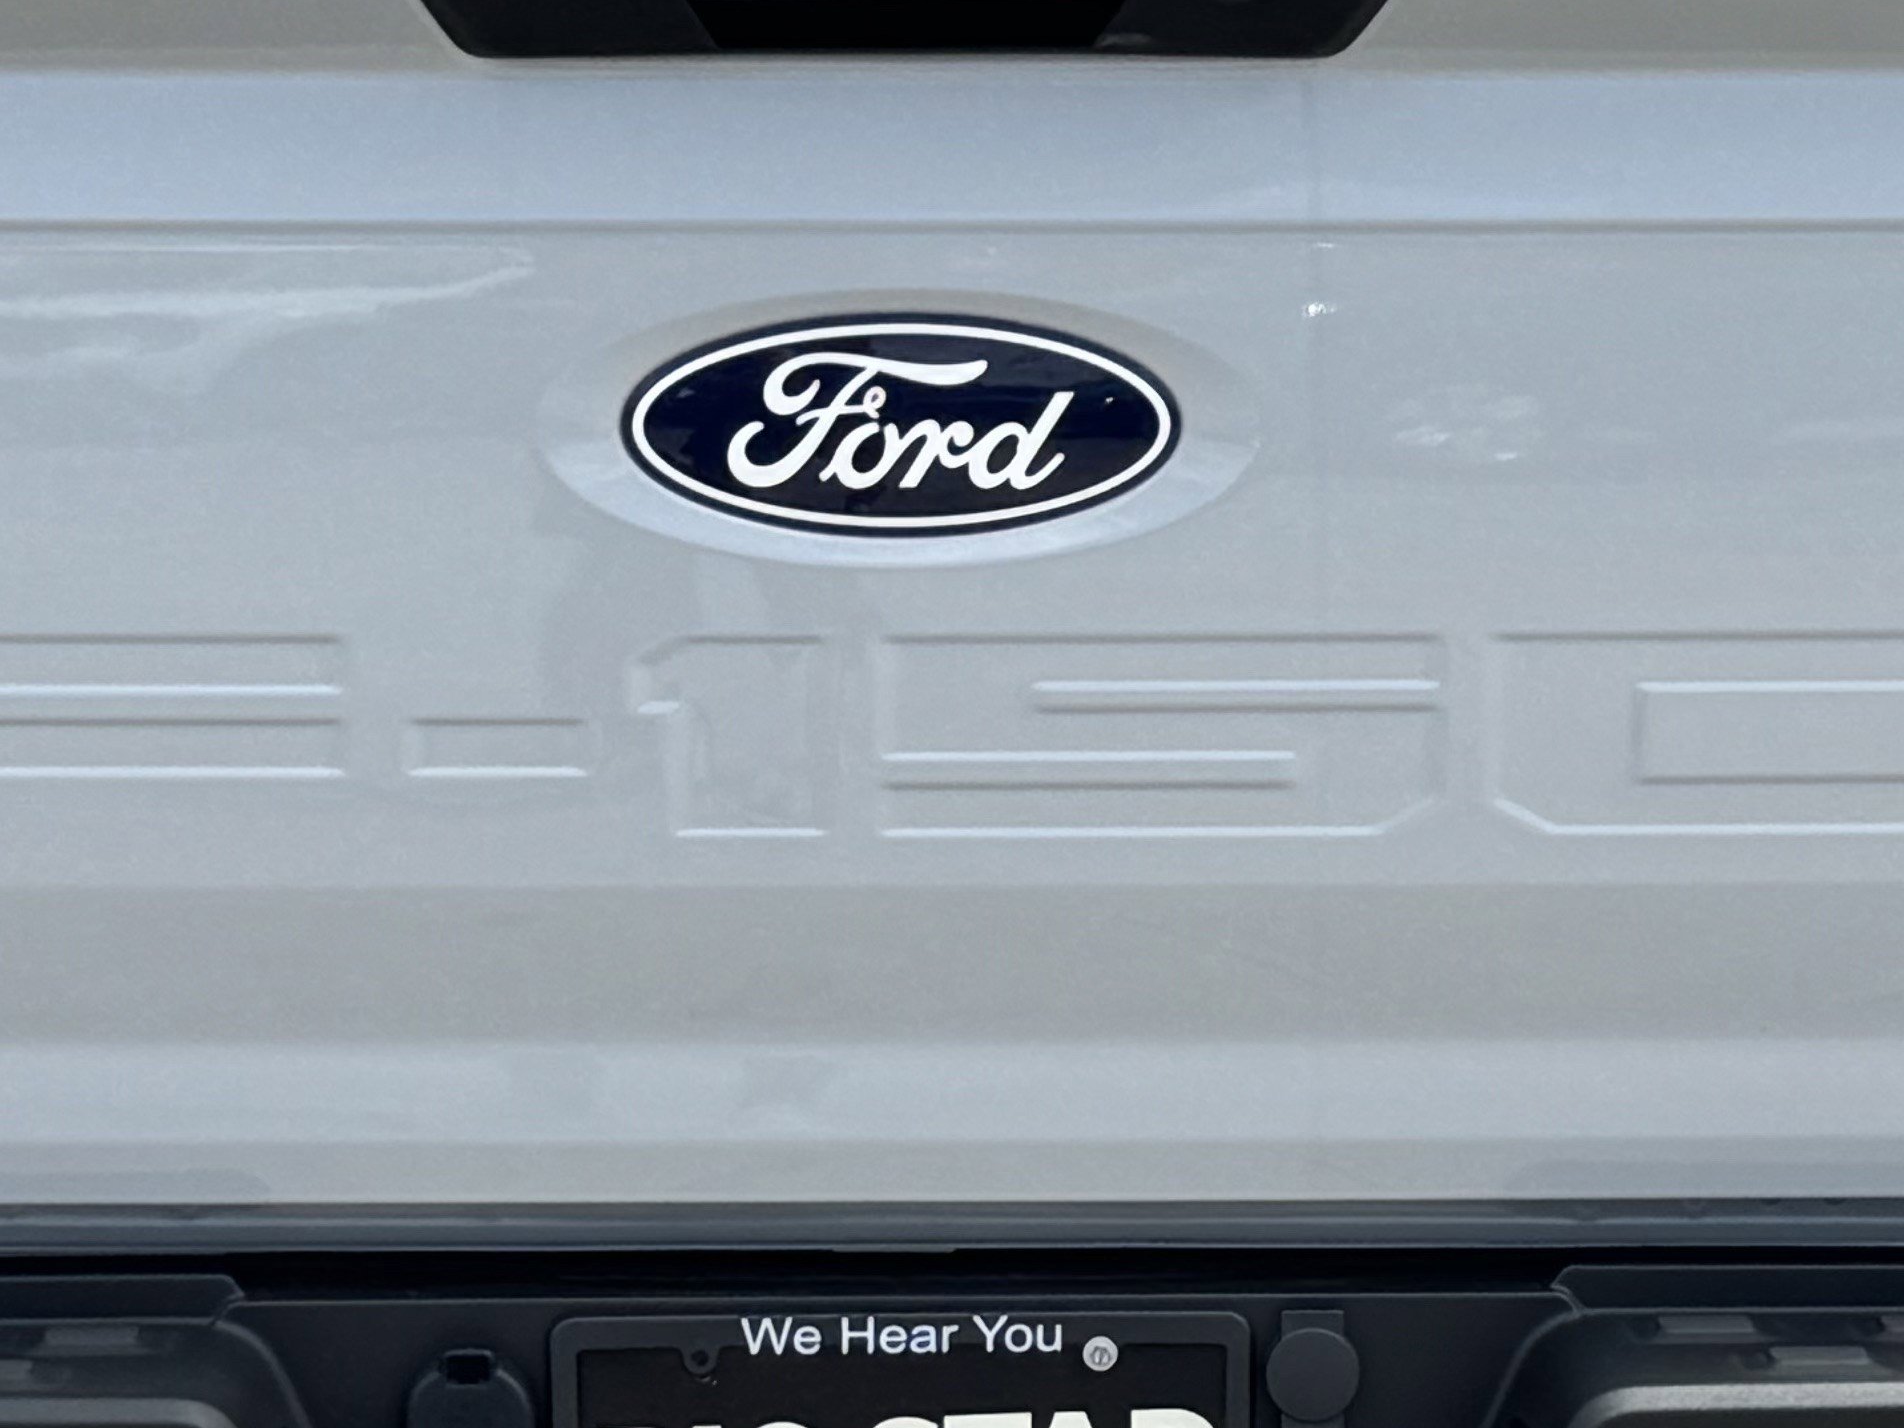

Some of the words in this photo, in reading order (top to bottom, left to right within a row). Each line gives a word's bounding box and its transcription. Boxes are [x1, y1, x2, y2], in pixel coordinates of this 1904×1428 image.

[727, 351, 1075, 490] Ford
[741, 1316, 822, 1356] We
[840, 1315, 959, 1355] Hear
[973, 1314, 1063, 1353] You
